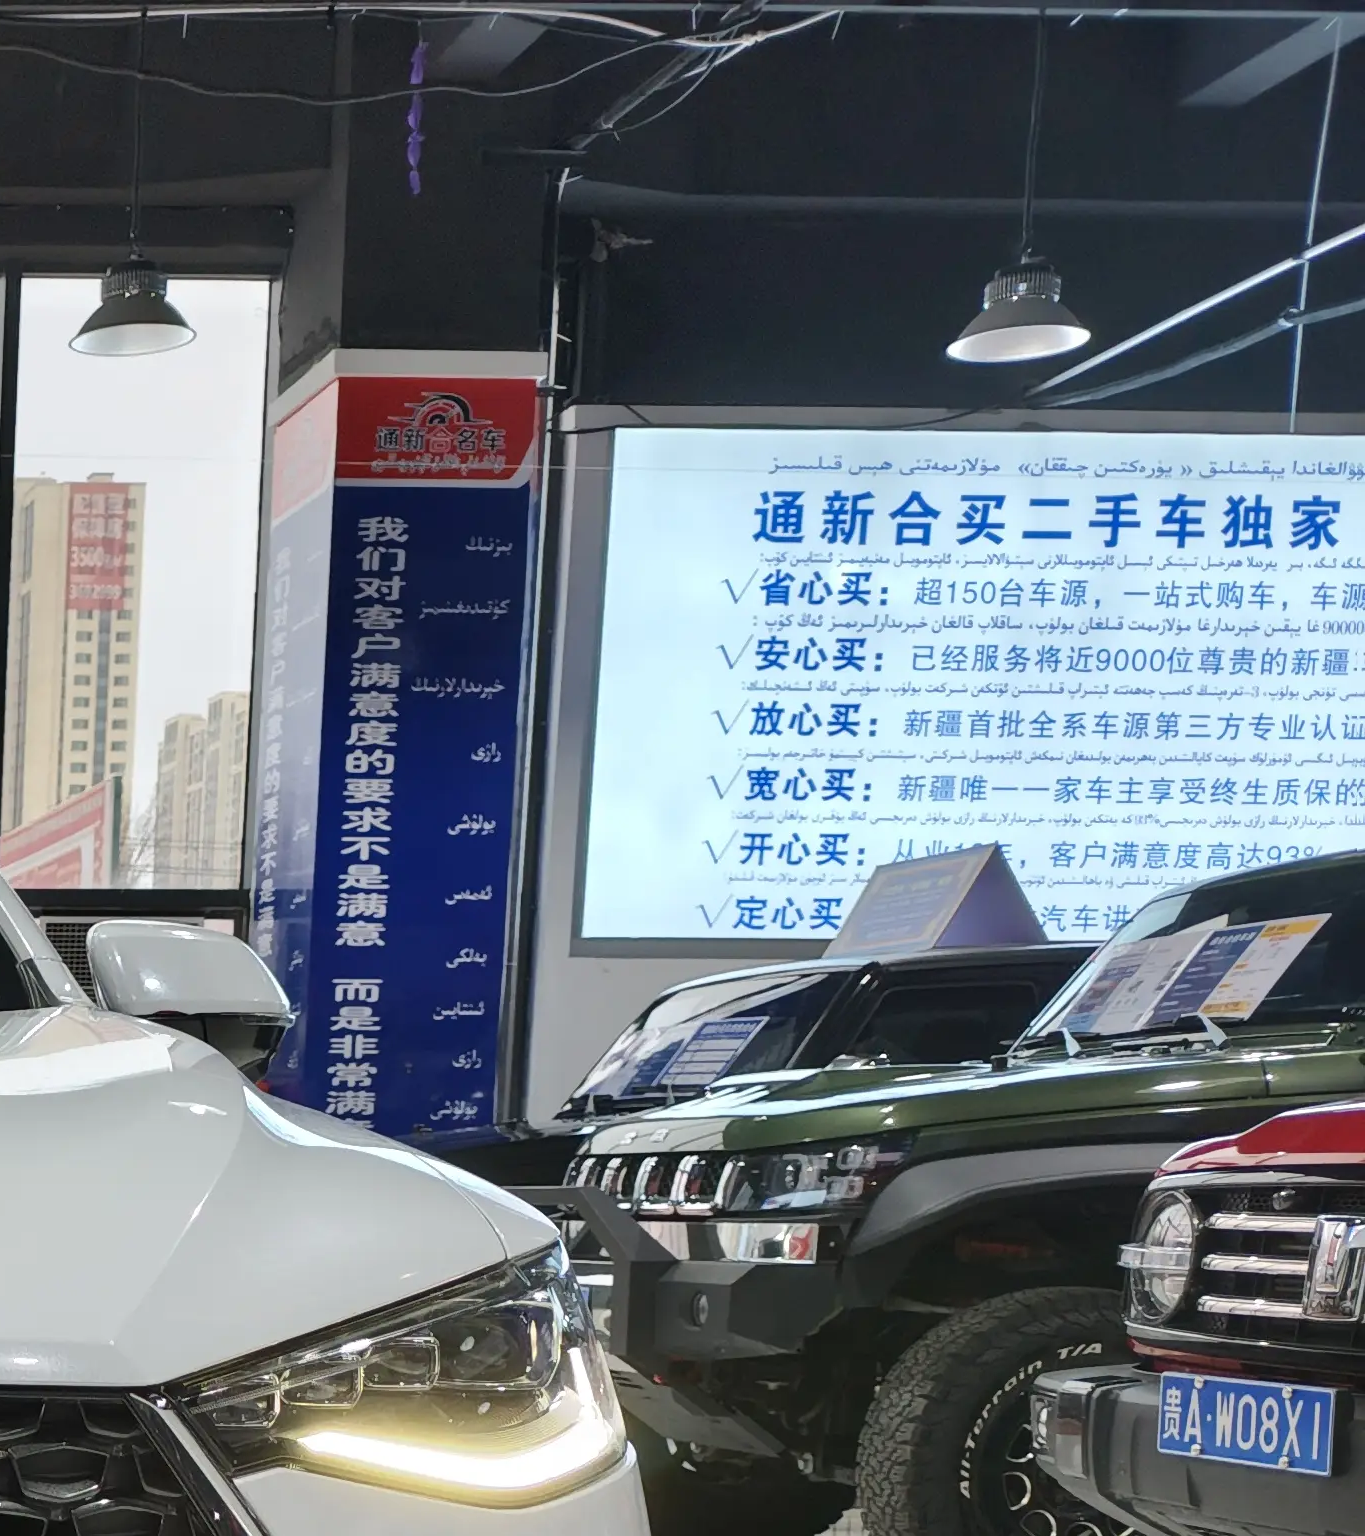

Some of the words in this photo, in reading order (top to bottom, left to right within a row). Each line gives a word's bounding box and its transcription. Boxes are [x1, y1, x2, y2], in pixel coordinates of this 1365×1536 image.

[375, 426, 506, 452] 通新合名车
[753, 489, 1341, 551] 通新合买二手车独家
[335, 516, 410, 947] 我们对客户满意度的要求不是满意
[1057, 1342, 1102, 1360] T/A
